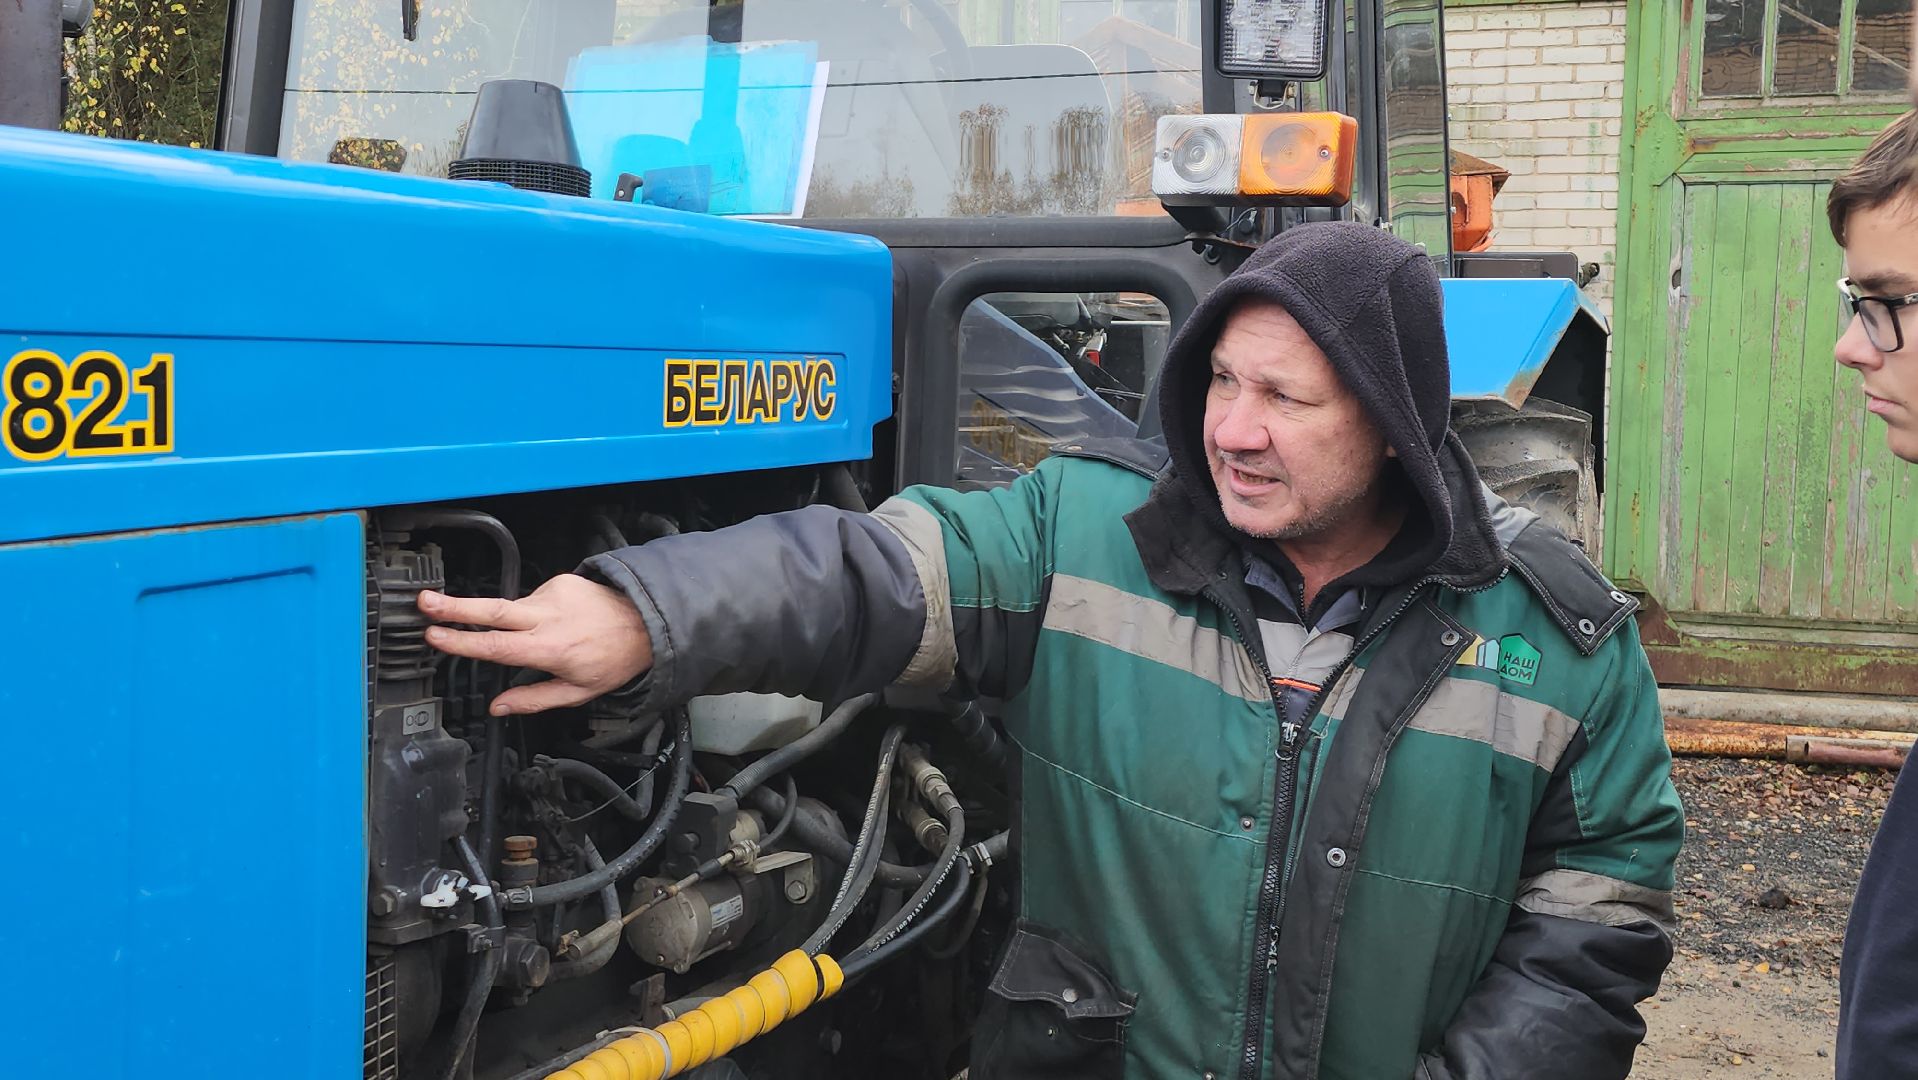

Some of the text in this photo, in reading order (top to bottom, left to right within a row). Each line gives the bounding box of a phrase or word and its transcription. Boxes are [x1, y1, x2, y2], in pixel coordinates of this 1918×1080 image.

[1, 349, 174, 461] 82.1
[663, 358, 837, 428] БЕЛАРУС
[1500, 665, 1532, 680] ДОМ
[1503, 651, 1535, 669] НАШ
